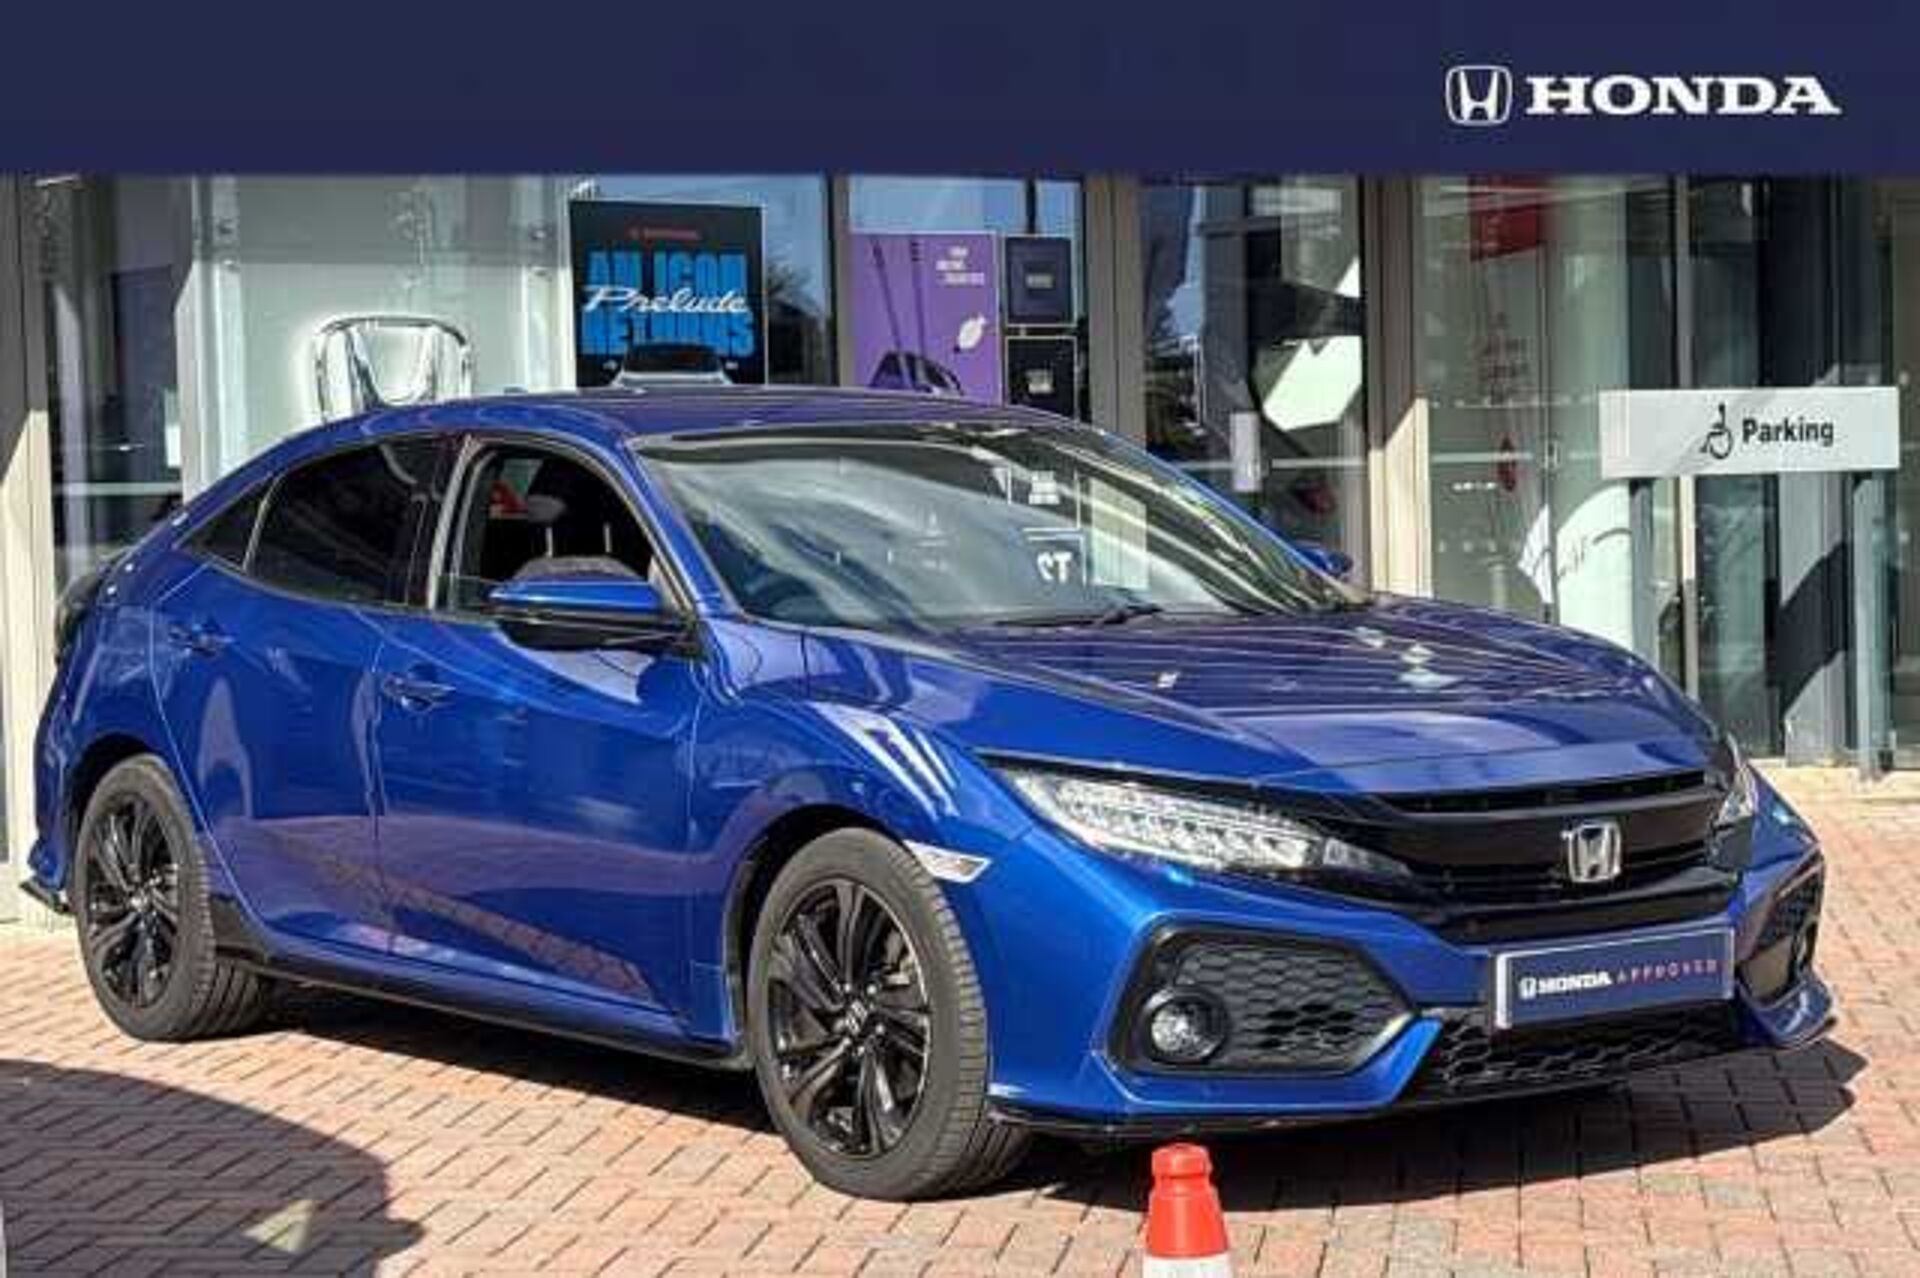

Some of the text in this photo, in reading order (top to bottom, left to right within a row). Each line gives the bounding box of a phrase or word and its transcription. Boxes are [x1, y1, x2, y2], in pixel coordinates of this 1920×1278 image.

[583, 286, 749, 314] Prelude
[1742, 418, 1834, 446] Parking
[1538, 970, 1612, 994] HONDA
